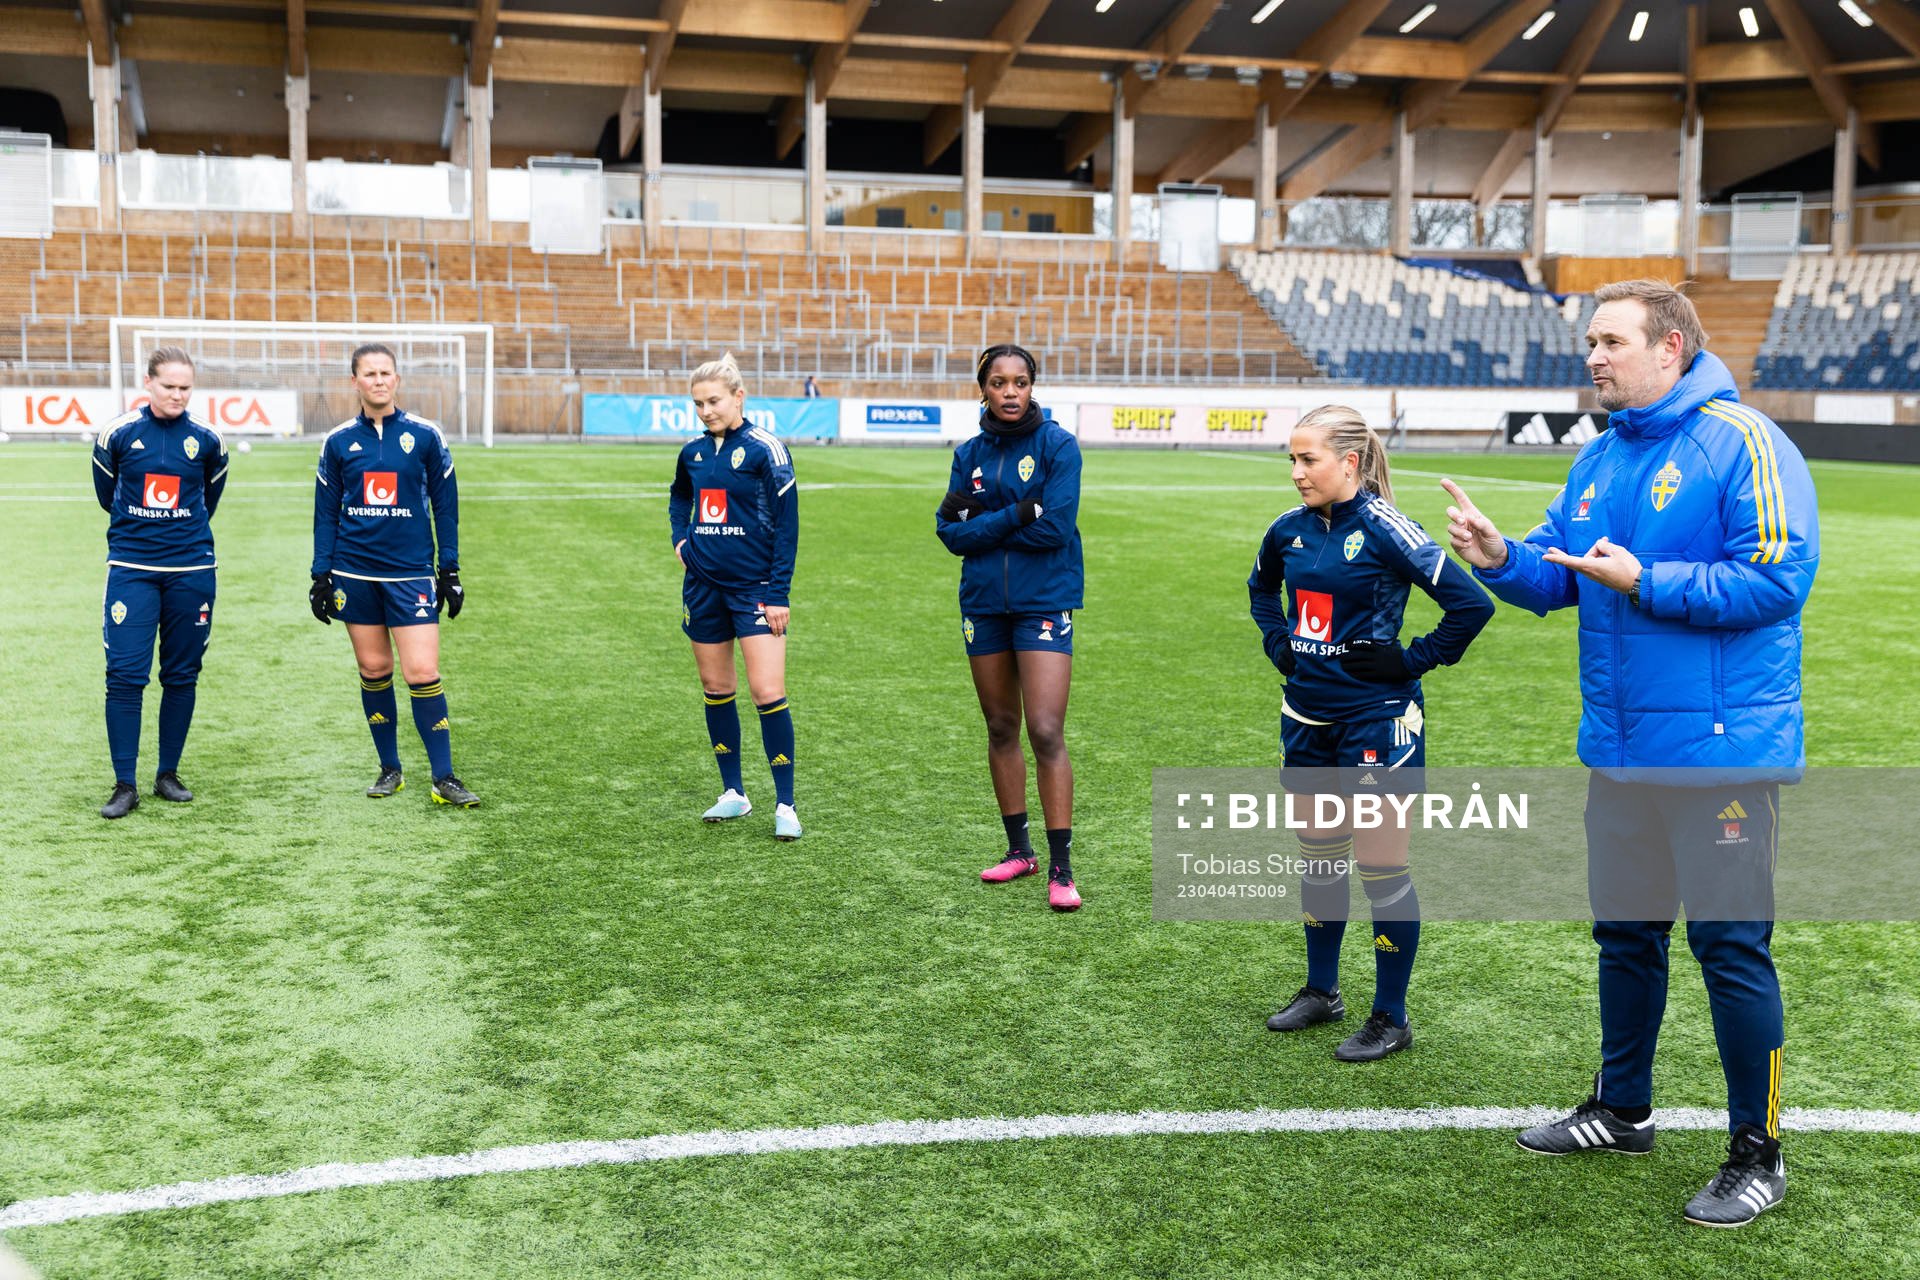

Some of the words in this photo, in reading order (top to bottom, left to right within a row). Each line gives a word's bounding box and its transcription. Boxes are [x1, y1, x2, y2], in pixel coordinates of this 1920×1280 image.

[25, 395, 92, 425] ICA
[208, 396, 272, 426] ICA
[650, 399, 777, 432] Folm
[1112, 406, 1176, 431] SPORT
[1206, 408, 1268, 432] SPORT
[128, 505, 170, 518] SVENSKA
[172, 508, 192, 518] SPEL
[347, 506, 389, 517] SVENSKA
[391, 508, 413, 518] SPEL
[721, 526, 746, 536] SPEL
[1319, 642, 1350, 656] SPEL
